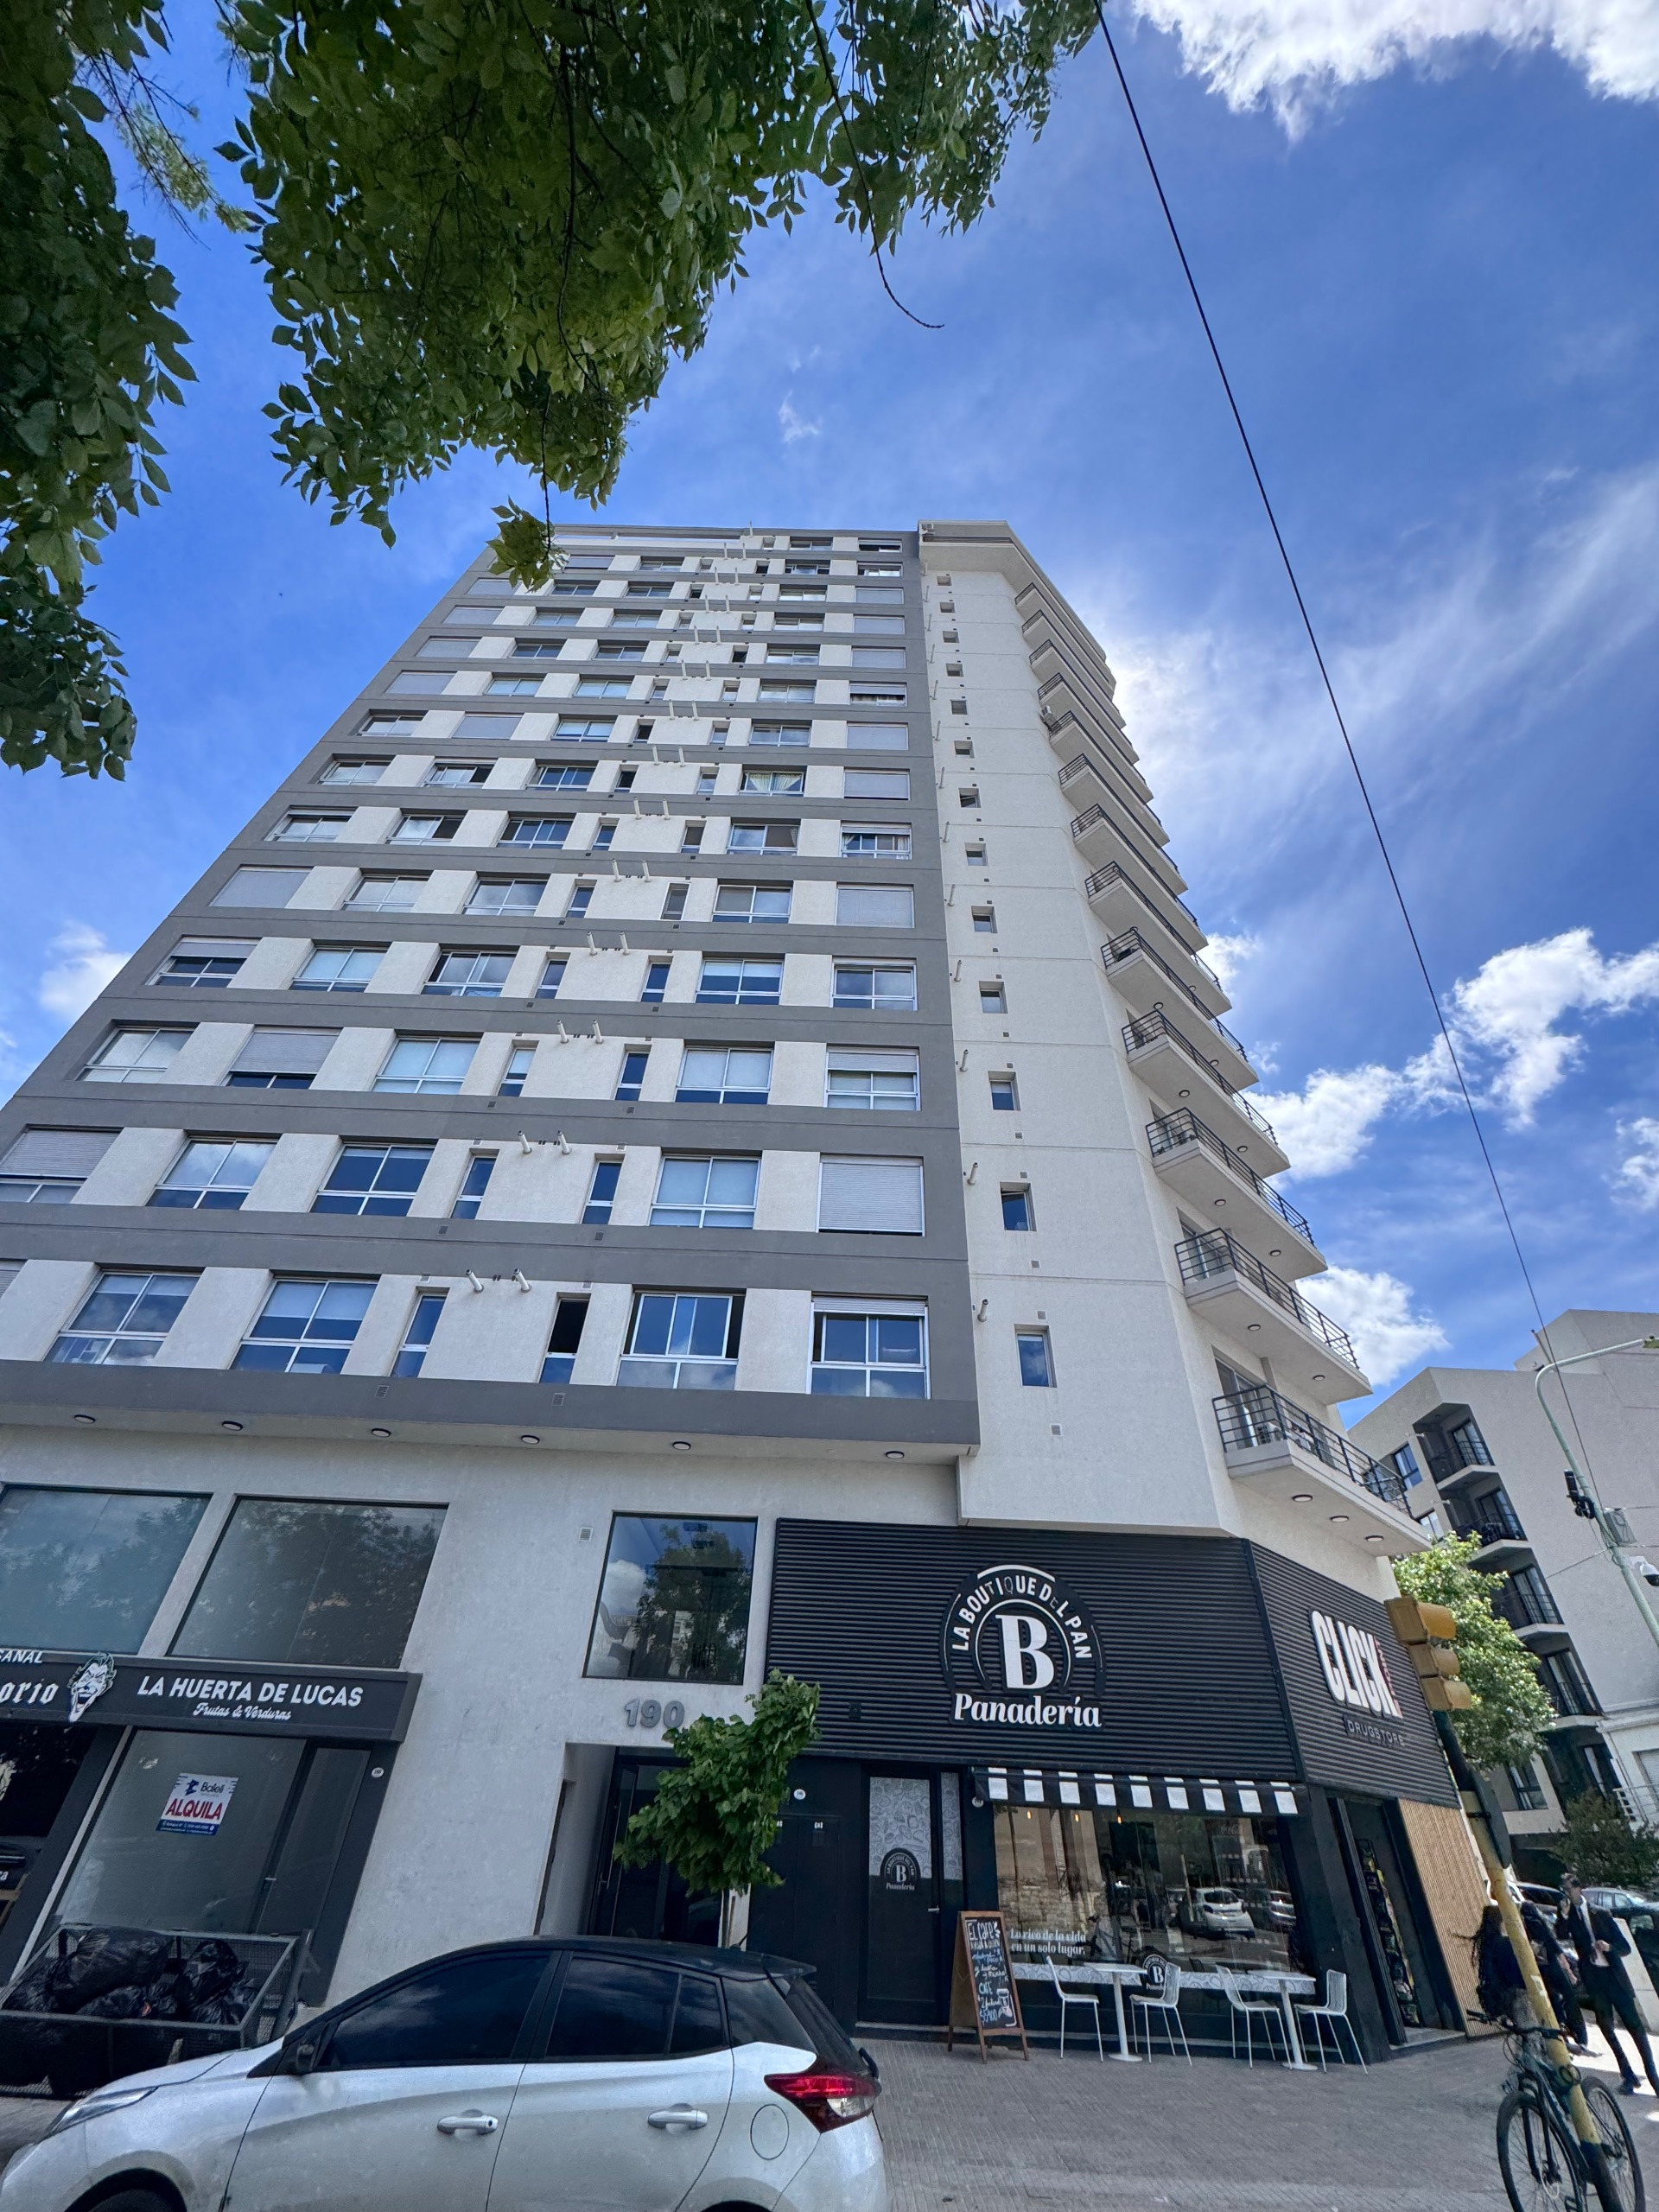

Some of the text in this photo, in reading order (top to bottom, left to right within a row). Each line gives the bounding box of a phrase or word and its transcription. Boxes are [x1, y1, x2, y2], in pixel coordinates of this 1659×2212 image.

[958, 1574, 1036, 1624] BOUTIQUE
[951, 1626, 970, 1651] LA
[1065, 1615, 1093, 1659] PAN
[995, 1614, 1055, 1689] B
[1312, 1611, 1400, 1718] CLICK
[137, 1675, 364, 1707] LA HUERTA DE LUCAS
[193, 1702, 292, 1721] Frutas & Verduras
[624, 1698, 685, 1728] 190
[954, 1692, 1103, 1727] Panadería
[1347, 1720, 1406, 1746] DRUGSTORE
[165, 1798, 223, 1821] ALQUILA
[895, 1864, 908, 1883] B
[1010, 1928, 1086, 1942] Lo rico de la vida
[1011, 1942, 1086, 1958] en un solo lugar.
[1152, 1966, 1165, 1984] B
